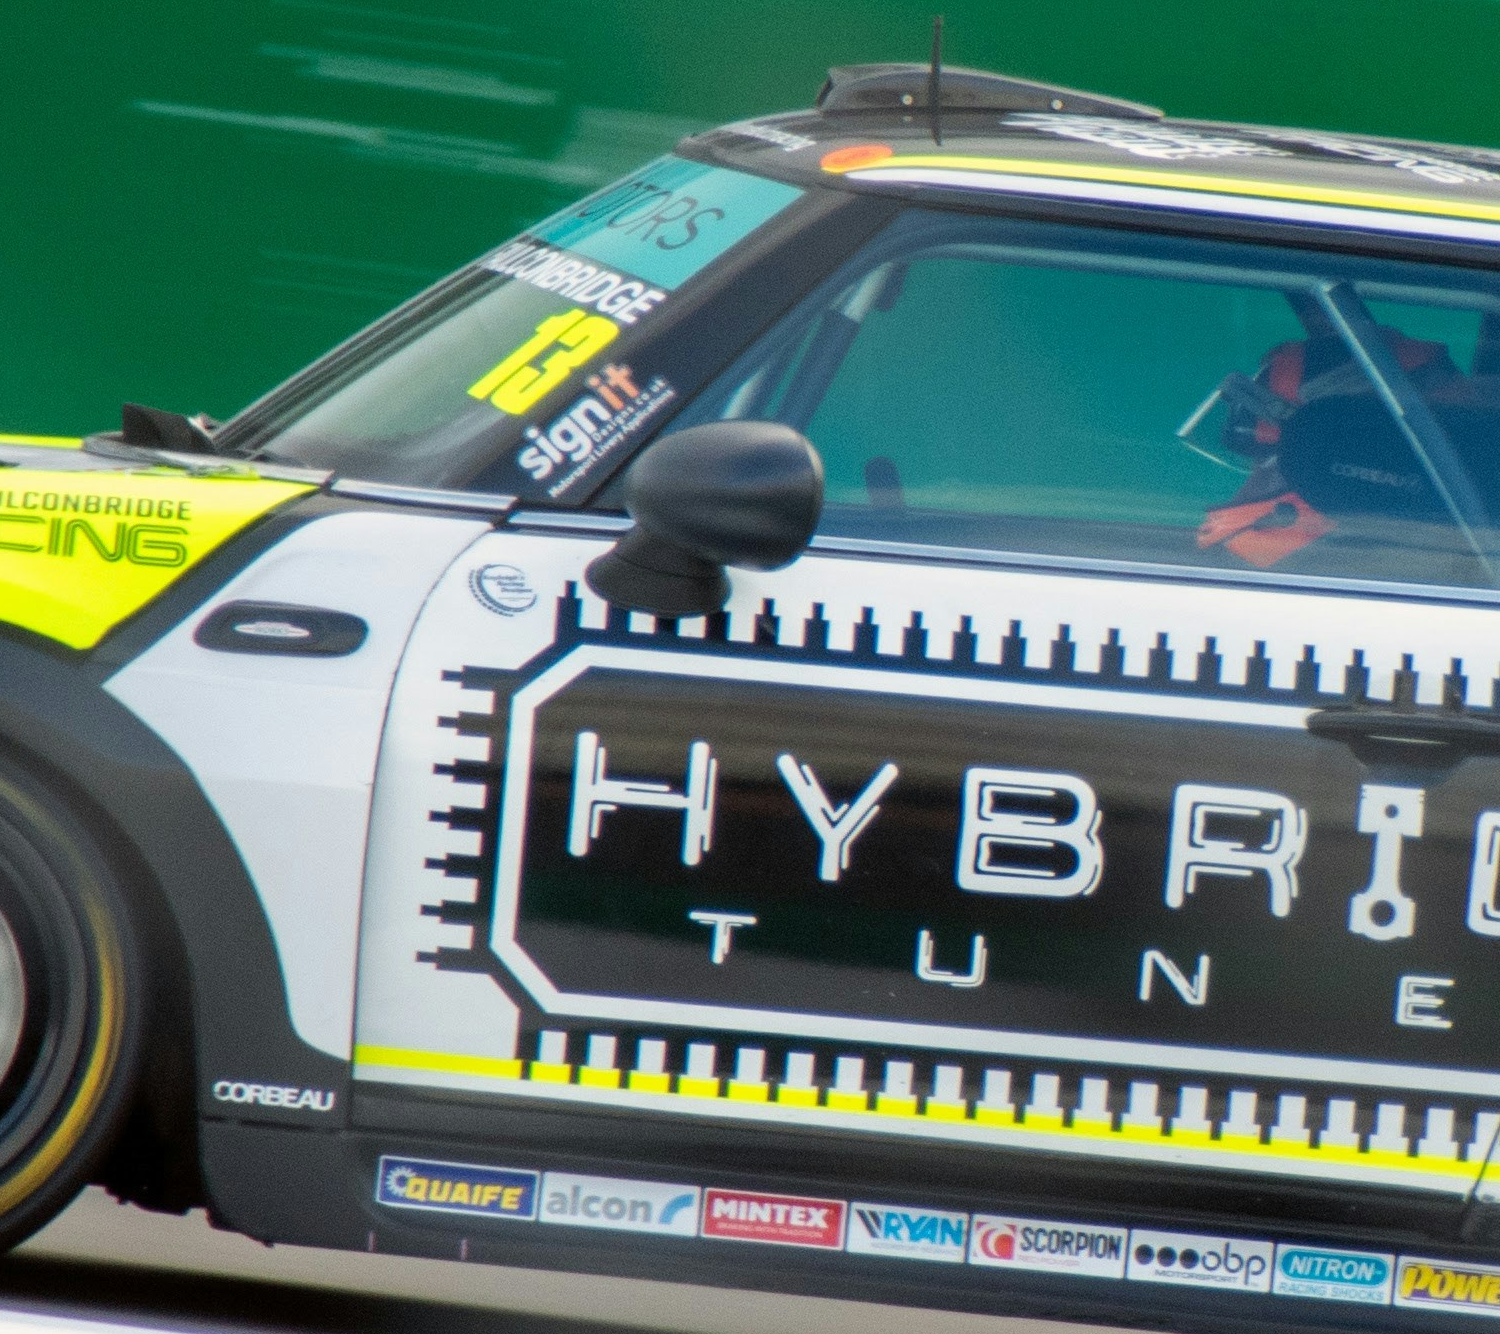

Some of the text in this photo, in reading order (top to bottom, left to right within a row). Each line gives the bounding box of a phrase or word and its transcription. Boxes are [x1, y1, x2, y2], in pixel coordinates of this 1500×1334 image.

[467, 308, 620, 415] 13
[690, 910, 1455, 1030] TUNE
[213, 1080, 334, 1111] CORBEAU
[405, 1175, 525, 1211] QUAIFE
[546, 1185, 652, 1223] alcon
[712, 1197, 828, 1229] MINTEX
[882, 1211, 964, 1247] RYAN
[1020, 1226, 1124, 1261] SCORPION
[1202, 1242, 1267, 1286] obp
[1288, 1254, 1374, 1281] NITRON
[1330, 1286, 1384, 1301] SHOCKS
